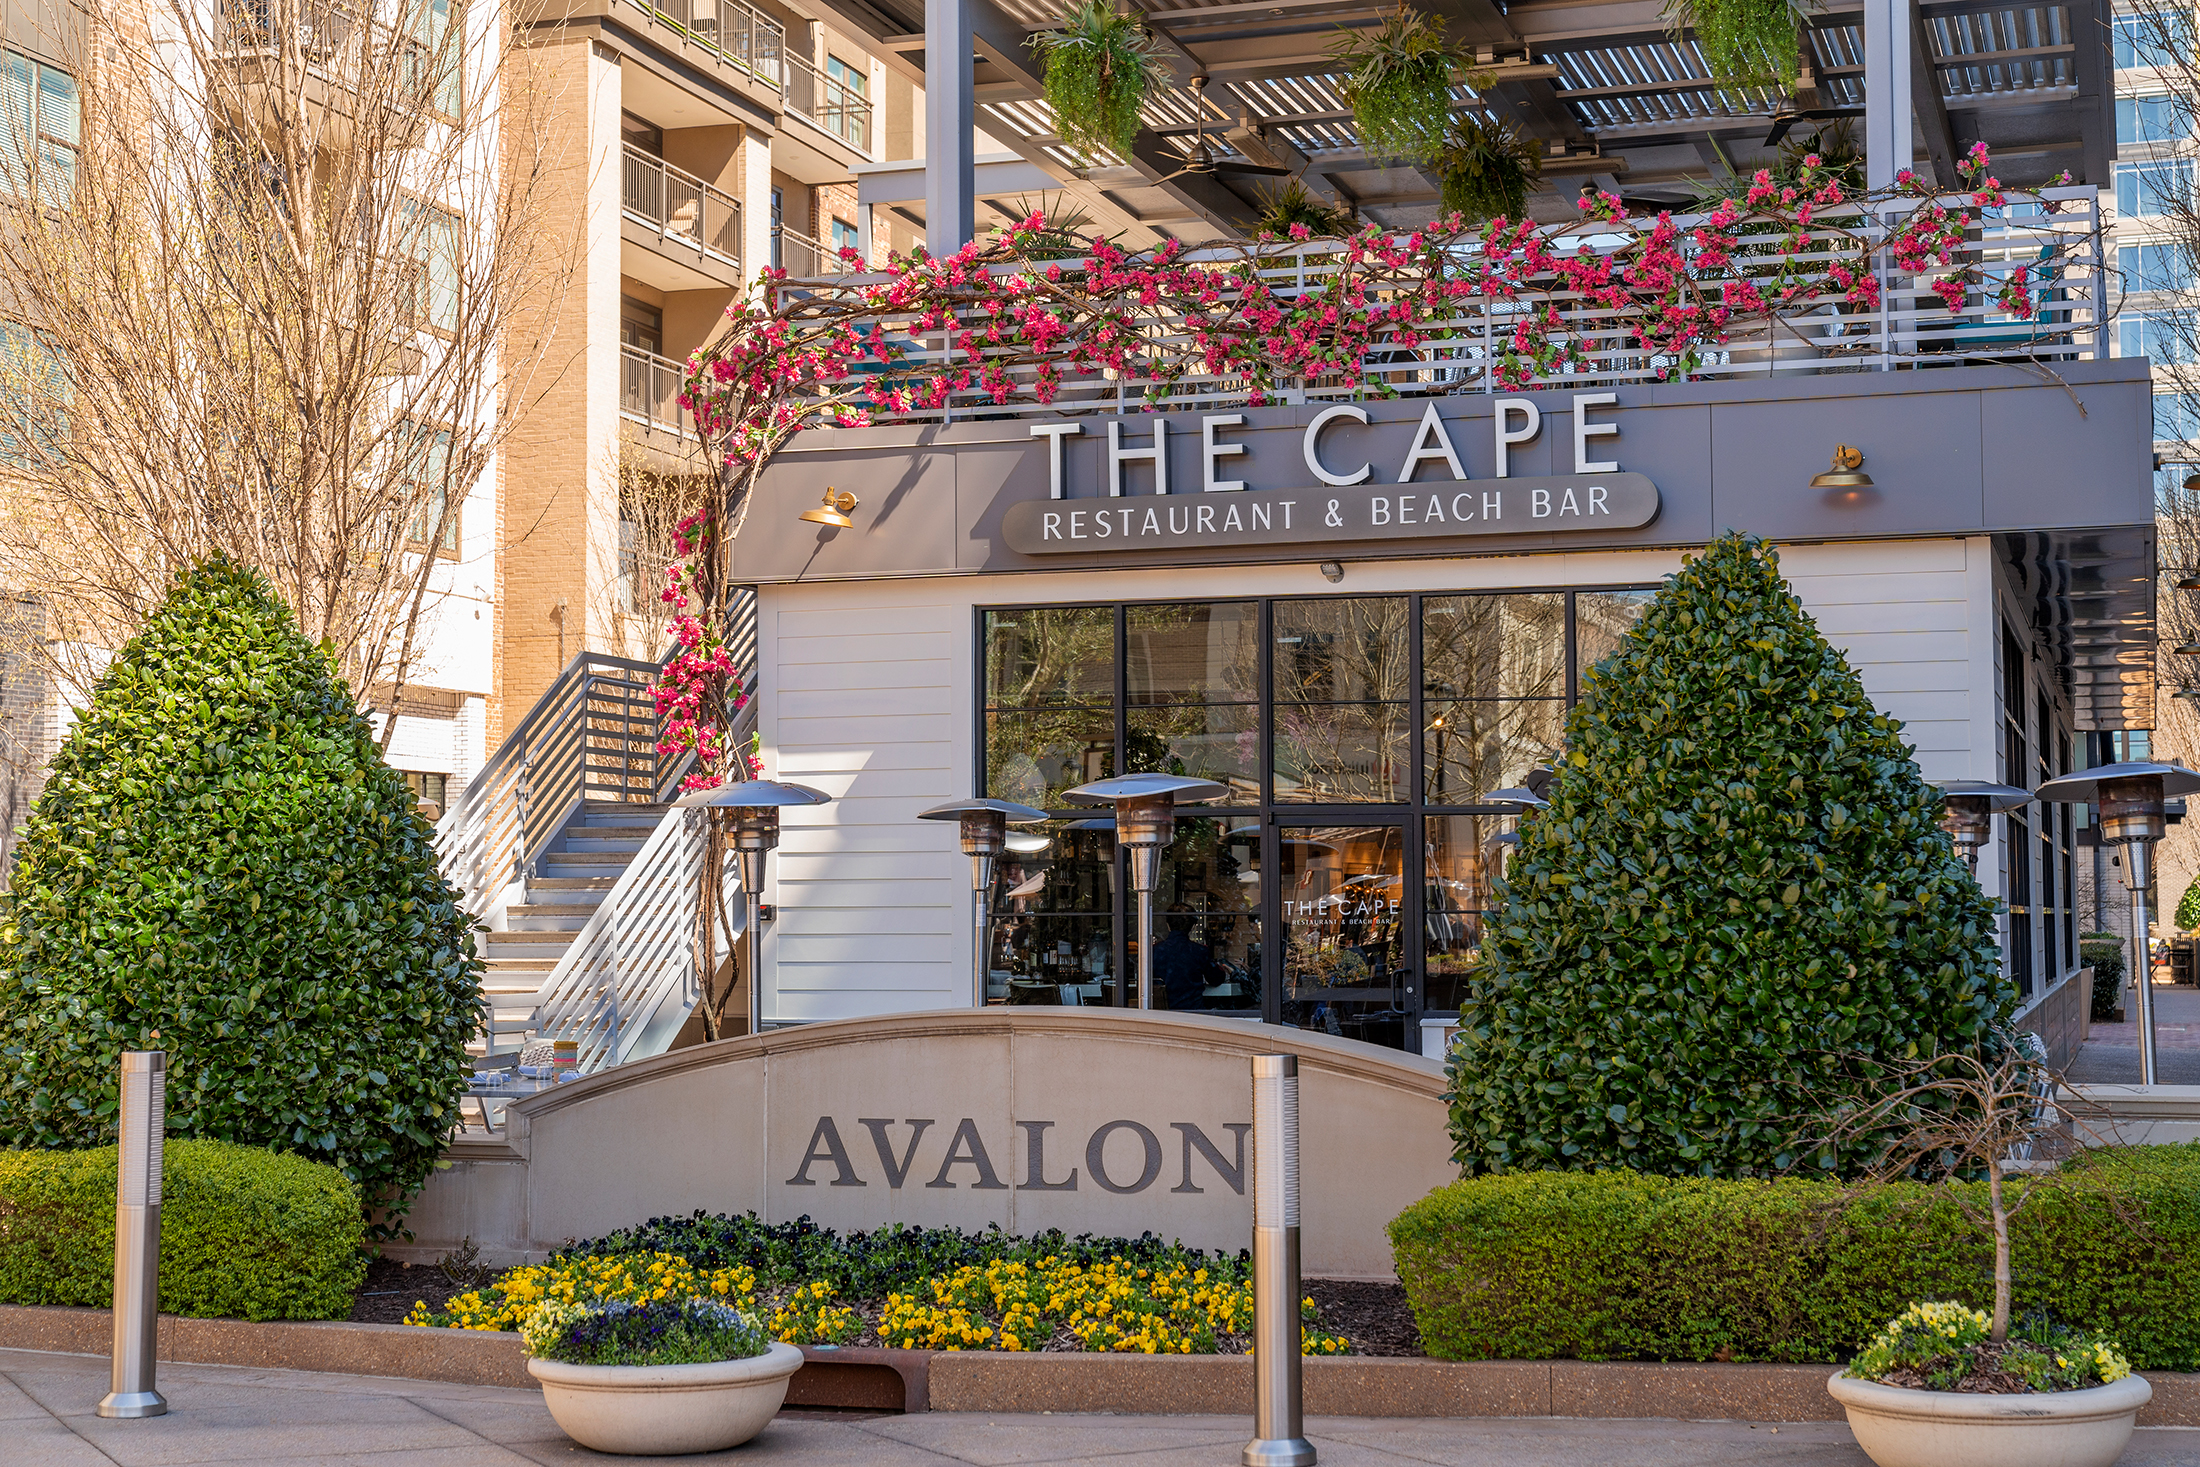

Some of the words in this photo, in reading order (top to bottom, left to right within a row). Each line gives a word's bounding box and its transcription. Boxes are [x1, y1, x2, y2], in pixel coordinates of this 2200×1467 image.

[1030, 414, 1247, 500] THE
[1302, 392, 1620, 486] CAPE
[1042, 501, 1296, 540] RESTAURANT
[1324, 498, 1343, 527] &
[1371, 492, 1502, 526] BEACH
[1531, 486, 1610, 518] BAR
[1283, 900, 1327, 916] THE
[1338, 899, 1399, 916] CAPE
[785, 1116, 1252, 1196] AVALON
